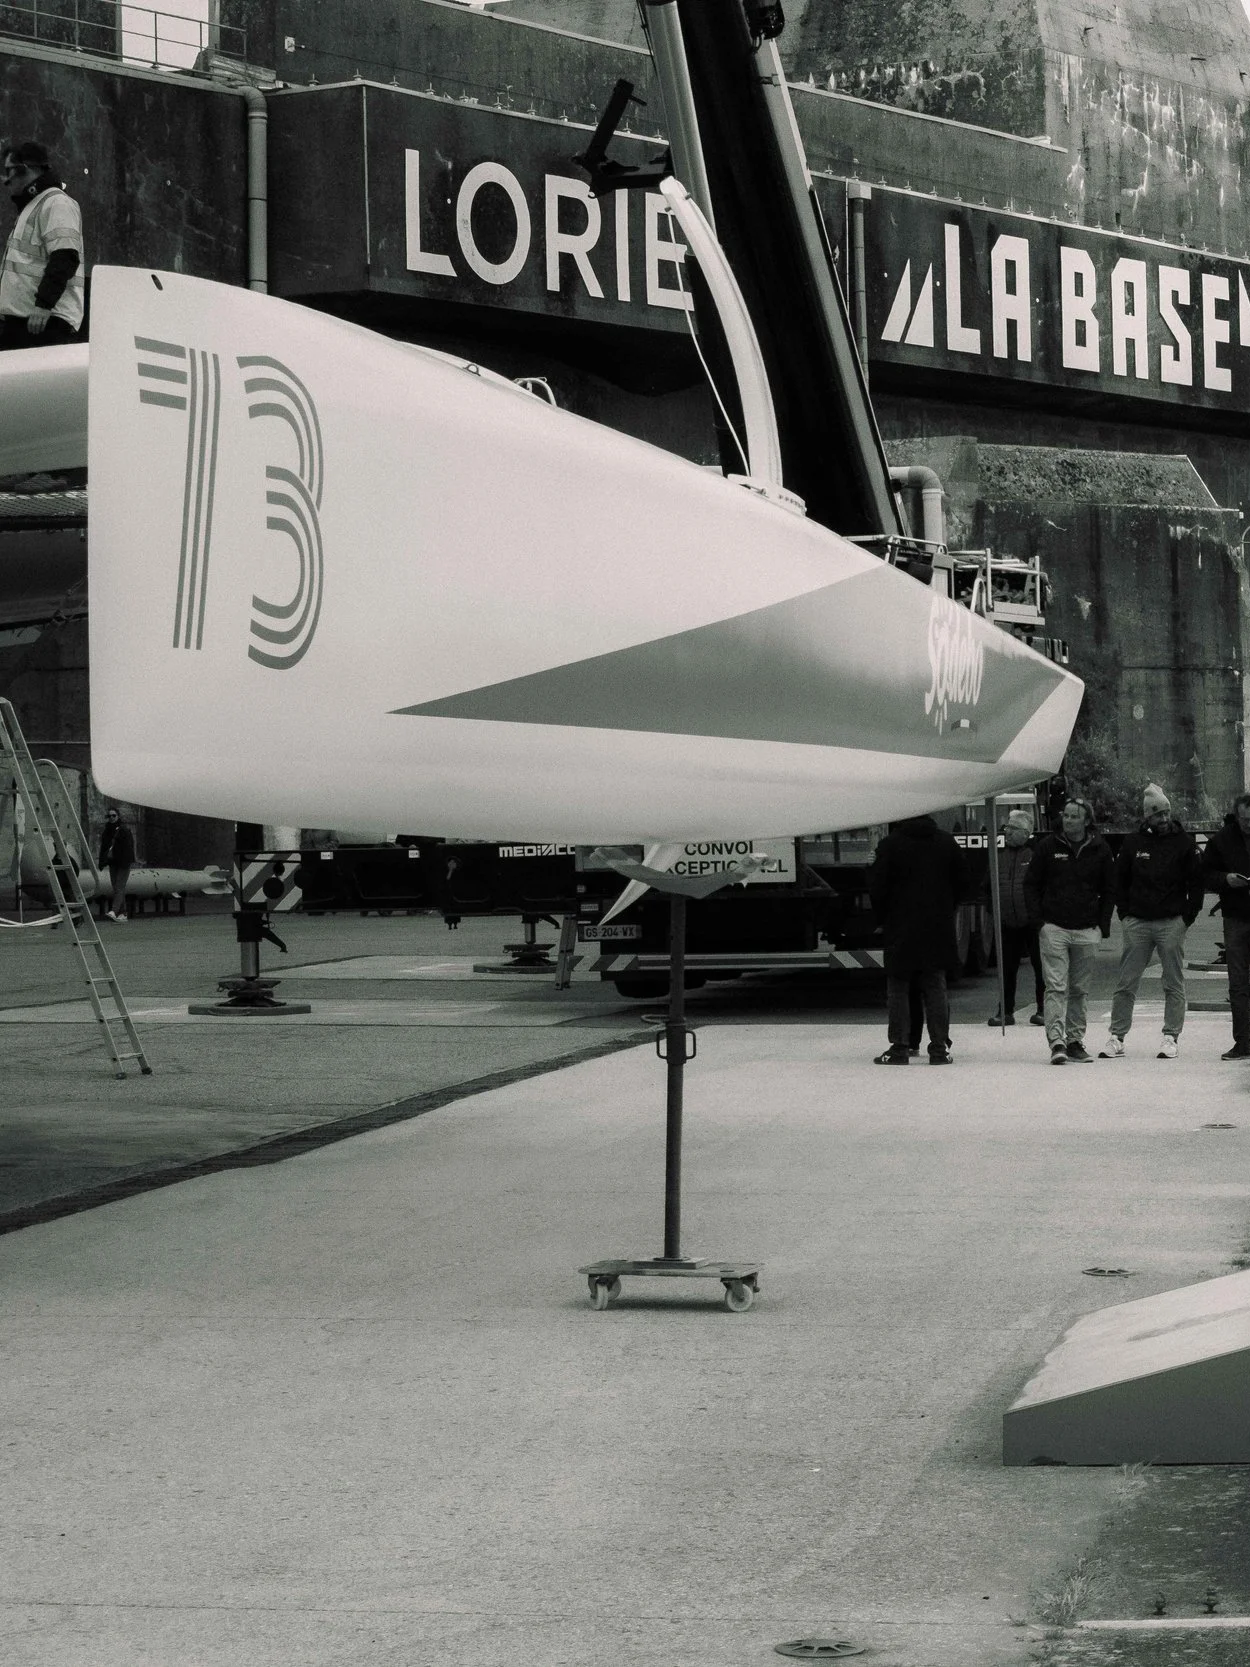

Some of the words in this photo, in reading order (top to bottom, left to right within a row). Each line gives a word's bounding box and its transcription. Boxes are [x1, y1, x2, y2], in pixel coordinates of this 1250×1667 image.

[405, 148, 695, 312] LORIE
[944, 223, 1032, 362] LA
[1060, 246, 1232, 392] BASE
[684, 841, 754, 855] CONVOI
